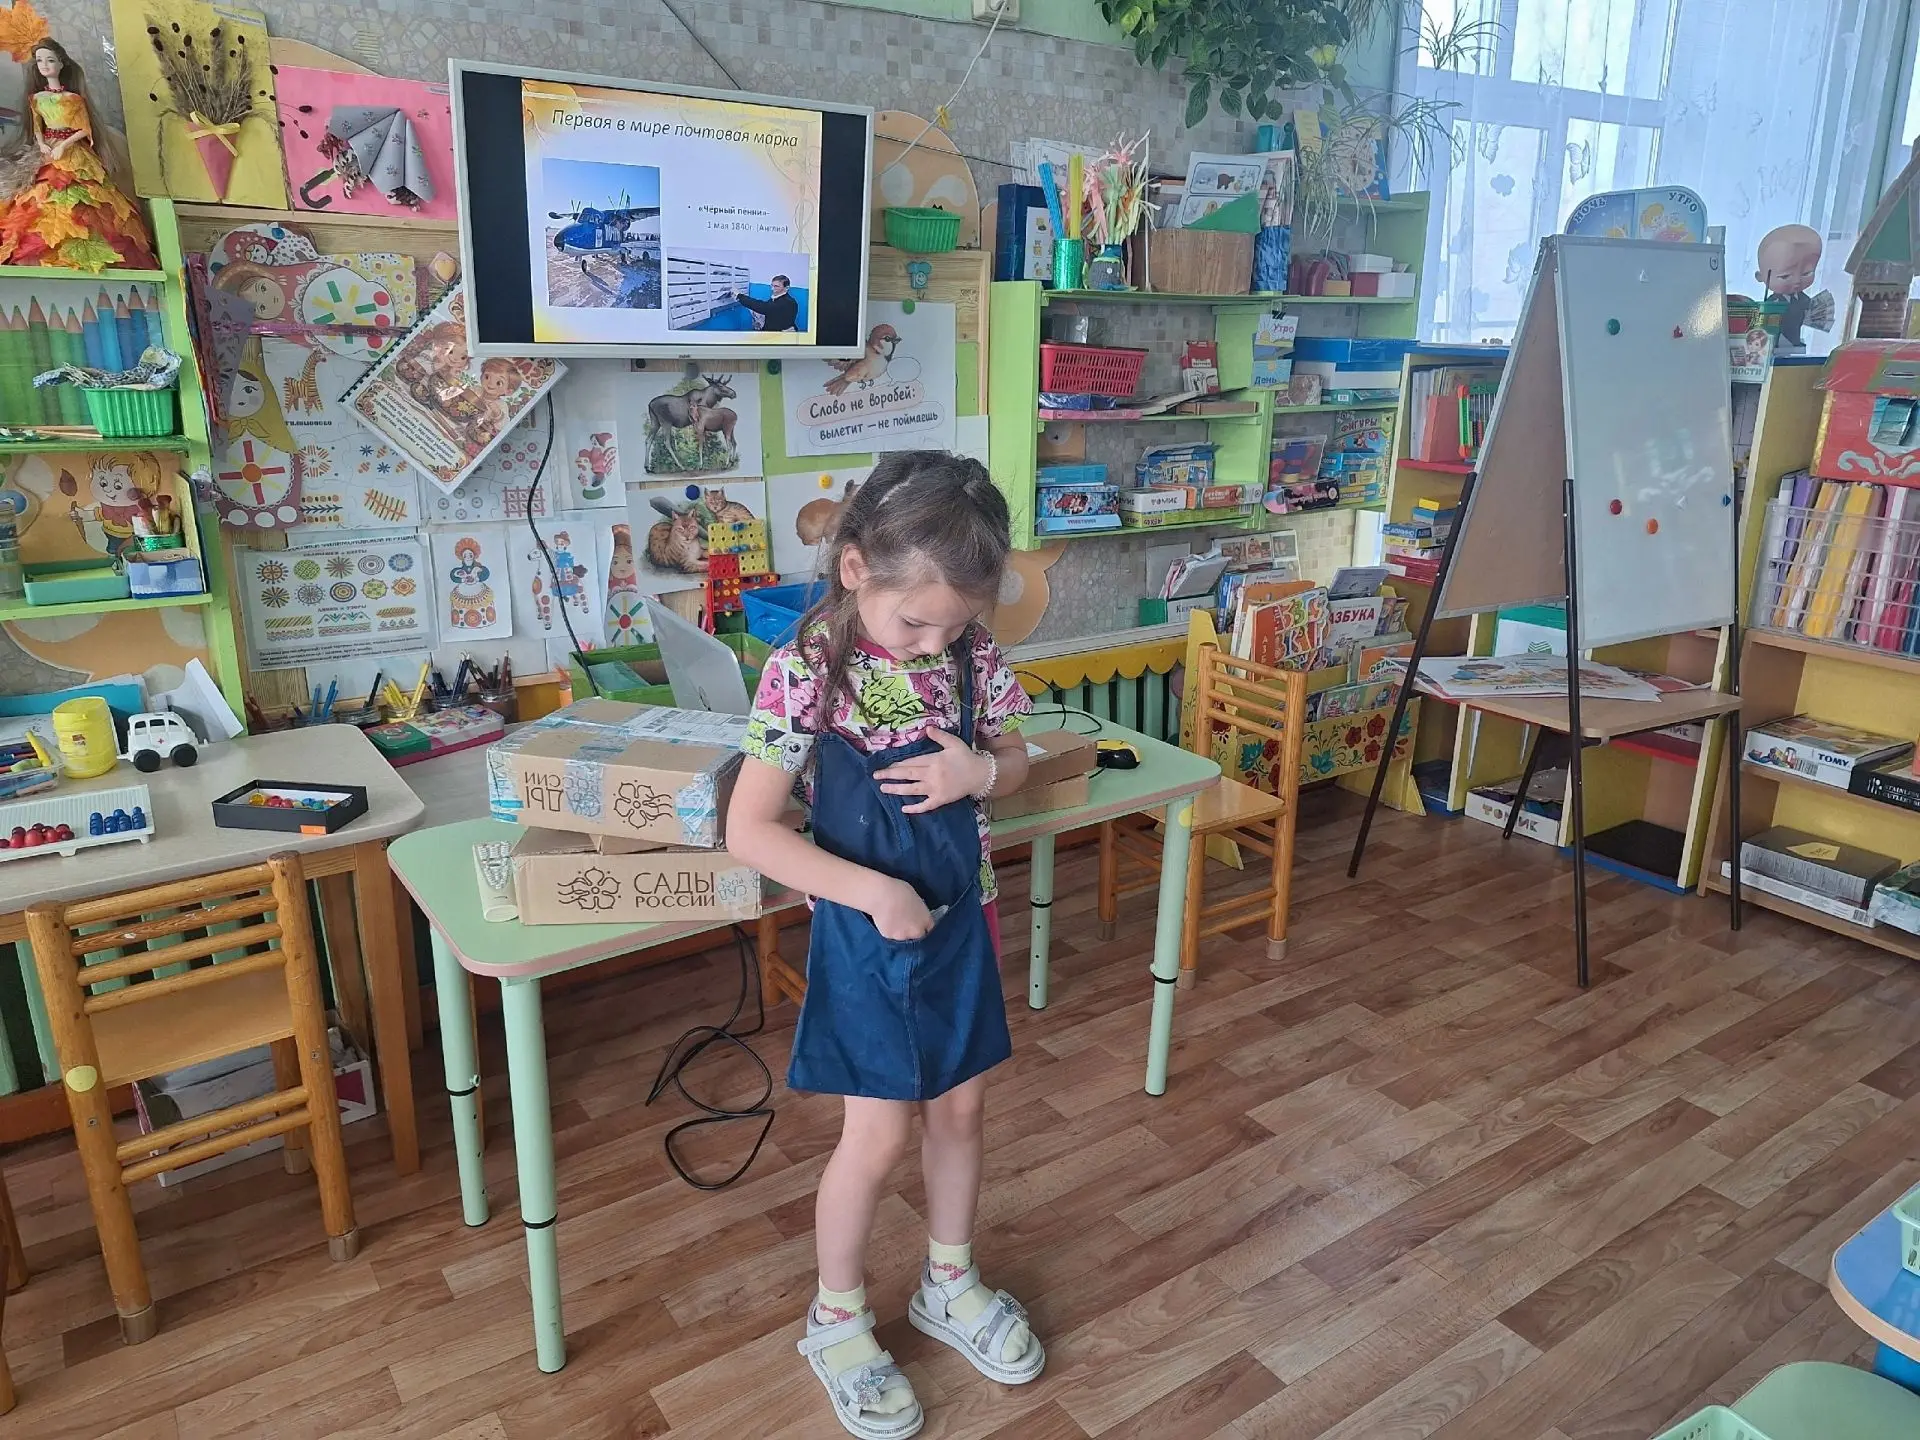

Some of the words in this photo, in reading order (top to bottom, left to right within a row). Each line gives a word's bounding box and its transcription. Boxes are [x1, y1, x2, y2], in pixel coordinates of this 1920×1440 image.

[552, 109, 611, 130] Первая
[616, 119, 626, 130] в
[630, 121, 670, 137] мире
[674, 124, 750, 143] почтовая
[753, 133, 799, 148] марка
[1668, 191, 1698, 212] УТРО
[1574, 198, 1606, 223] НОЧЬ
[713, 222, 729, 230] мая
[756, 223, 789, 234] (Англия)
[1273, 323, 1295, 335] Утро
[1731, 367, 1763, 376] НОСТИ
[1254, 376, 1277, 386] День
[809, 400, 846, 419] Слово
[850, 397, 864, 411] не
[869, 386, 916, 409] воробей:
[820, 423, 864, 440] вылетит
[878, 420, 890, 430] не
[893, 412, 938, 427] поймаешь
[1340, 418, 1378, 433] ФИГУРЫ
[1328, 607, 1375, 625] АЗБУКА
[1818, 753, 1849, 767] TOMY
[633, 871, 715, 895] САДЫ
[635, 895, 715, 908] РОССИИ
